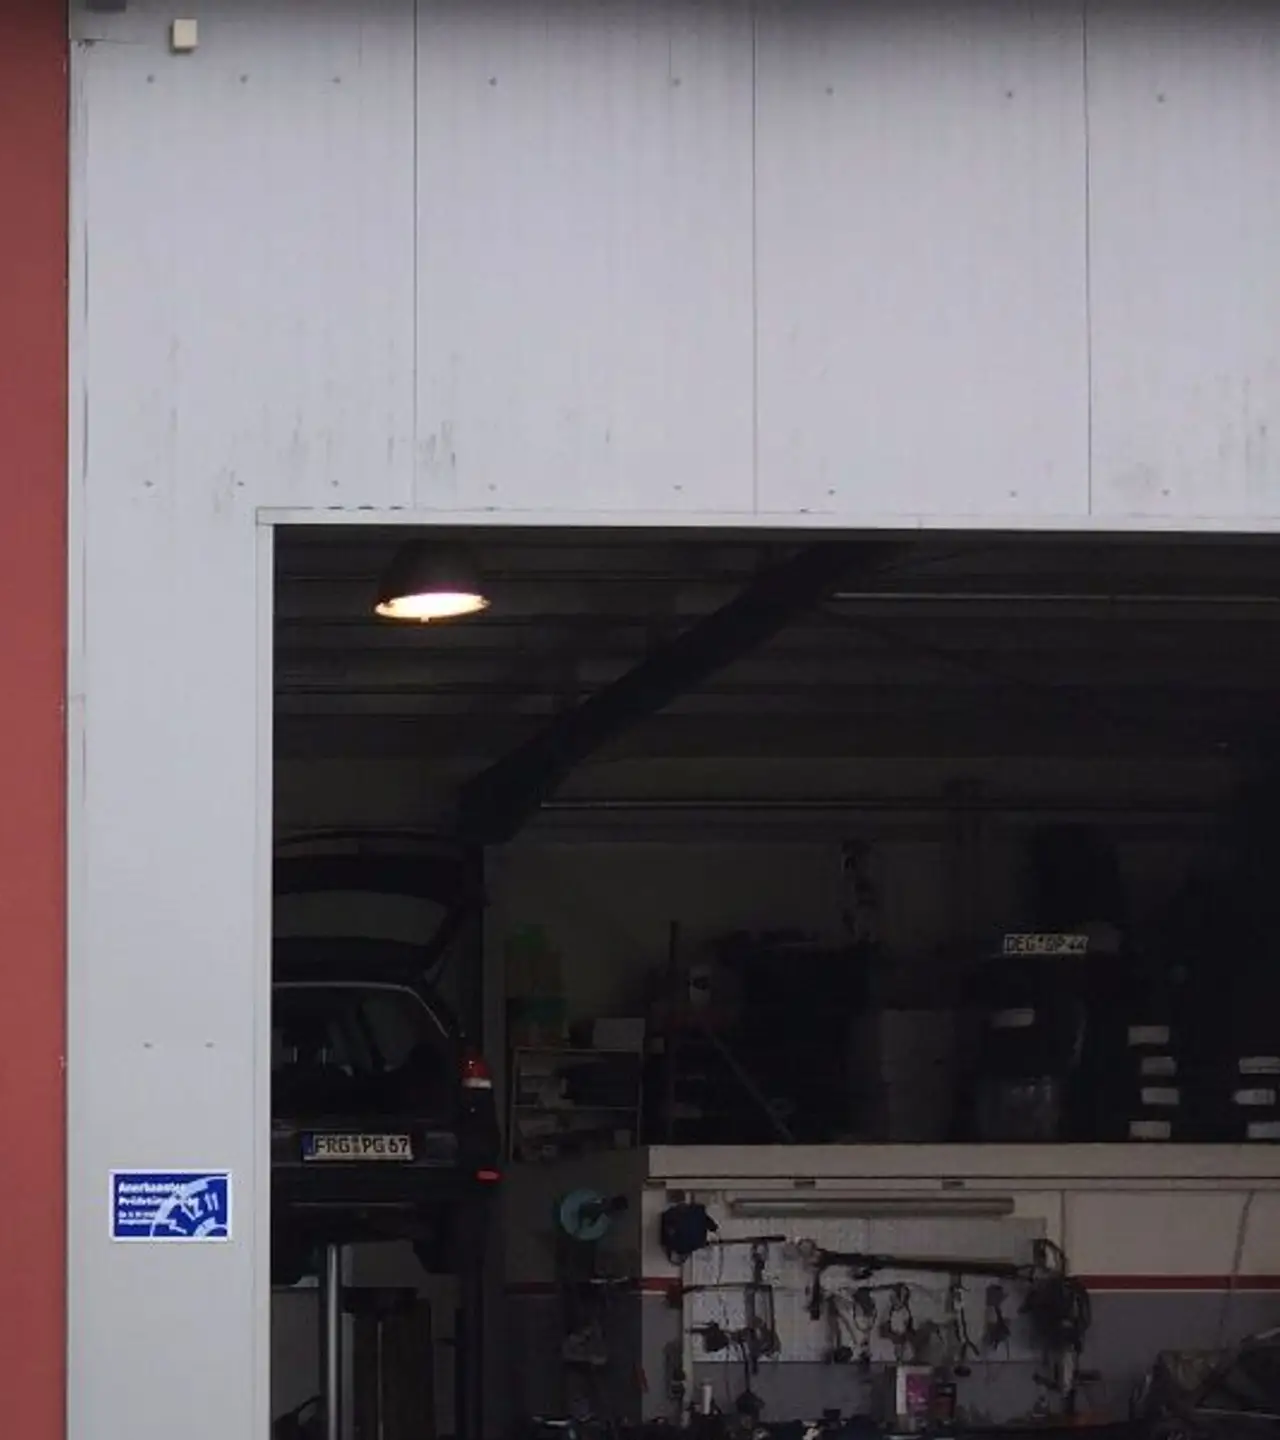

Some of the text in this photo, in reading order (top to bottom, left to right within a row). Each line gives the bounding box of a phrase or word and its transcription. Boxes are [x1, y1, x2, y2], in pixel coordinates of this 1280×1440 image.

[315, 1137, 408, 1154] FRG PG 67
